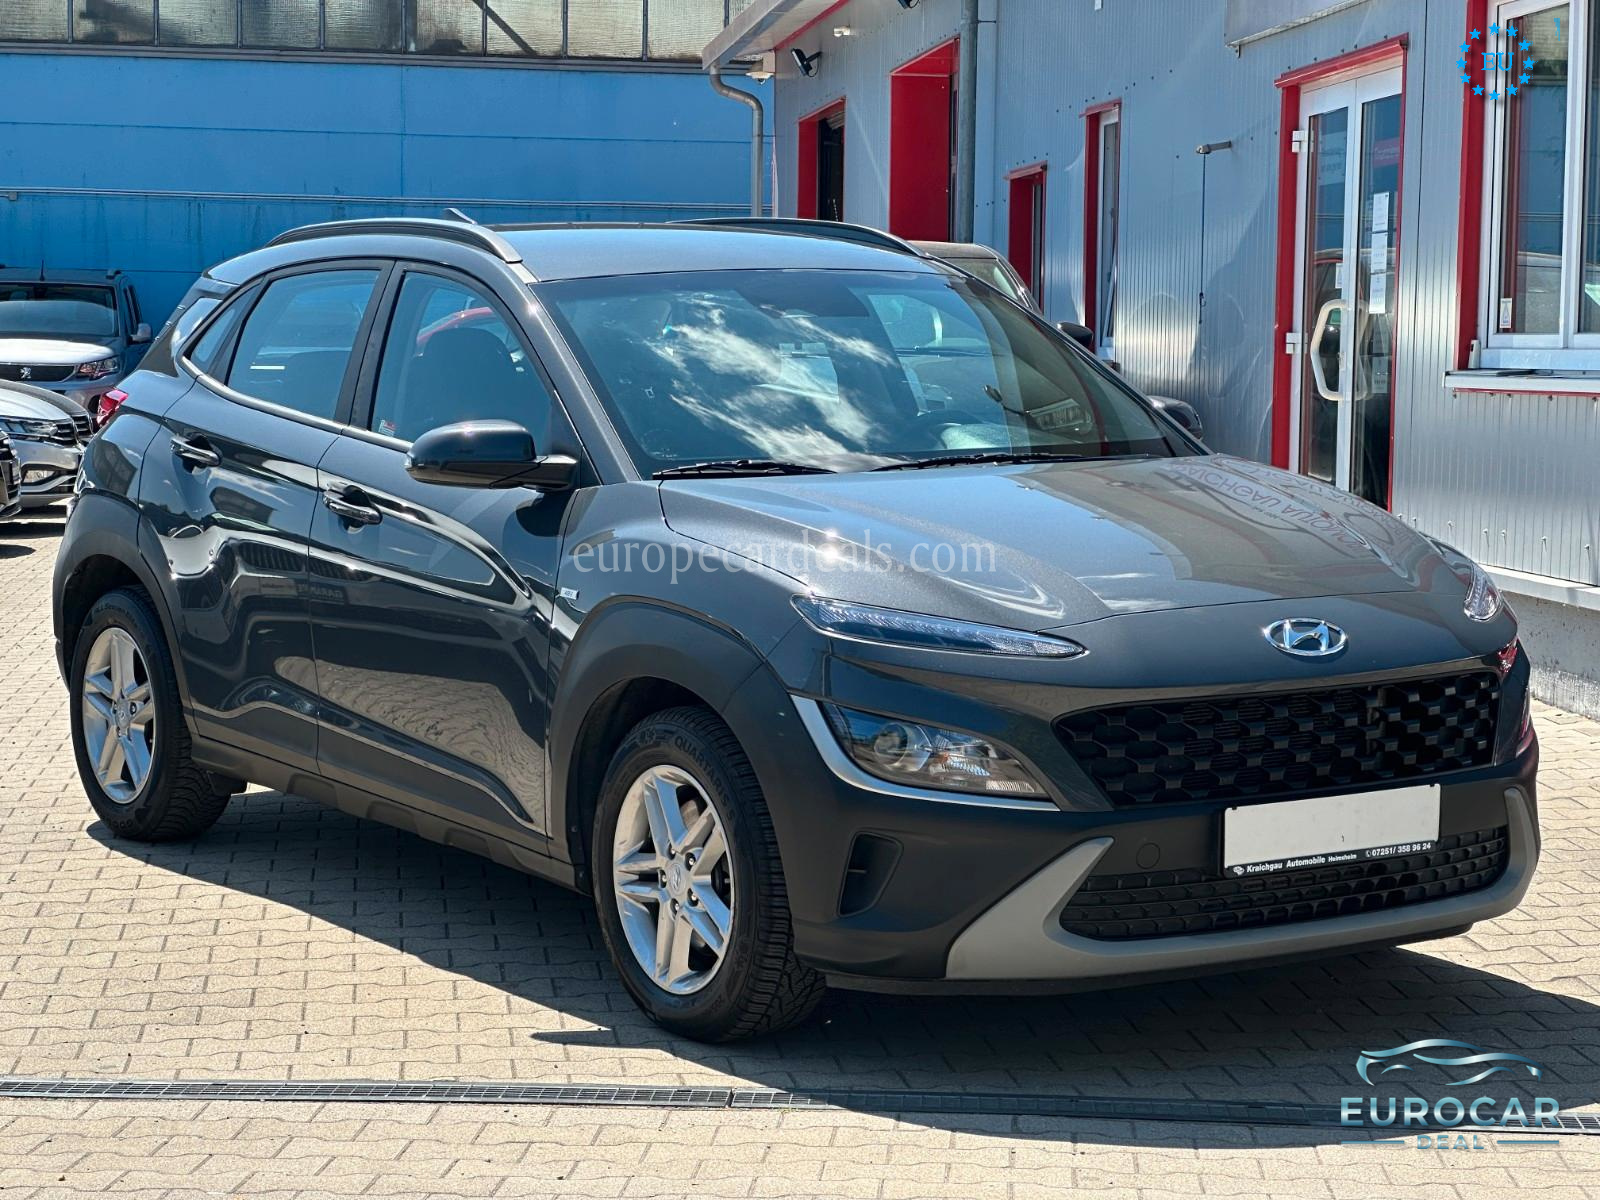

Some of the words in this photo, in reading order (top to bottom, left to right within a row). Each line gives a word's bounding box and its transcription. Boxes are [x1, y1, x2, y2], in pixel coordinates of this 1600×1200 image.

[674, 736, 728, 807] QUARTARIS
[1246, 862, 1283, 873] Kraichgau
[1286, 856, 1326, 869] Automobile
[1371, 846, 1396, 857] 07251/
[1397, 844, 1411, 854] 358
[1412, 843, 1421, 852] 96
[1422, 841, 1432, 851] 24
